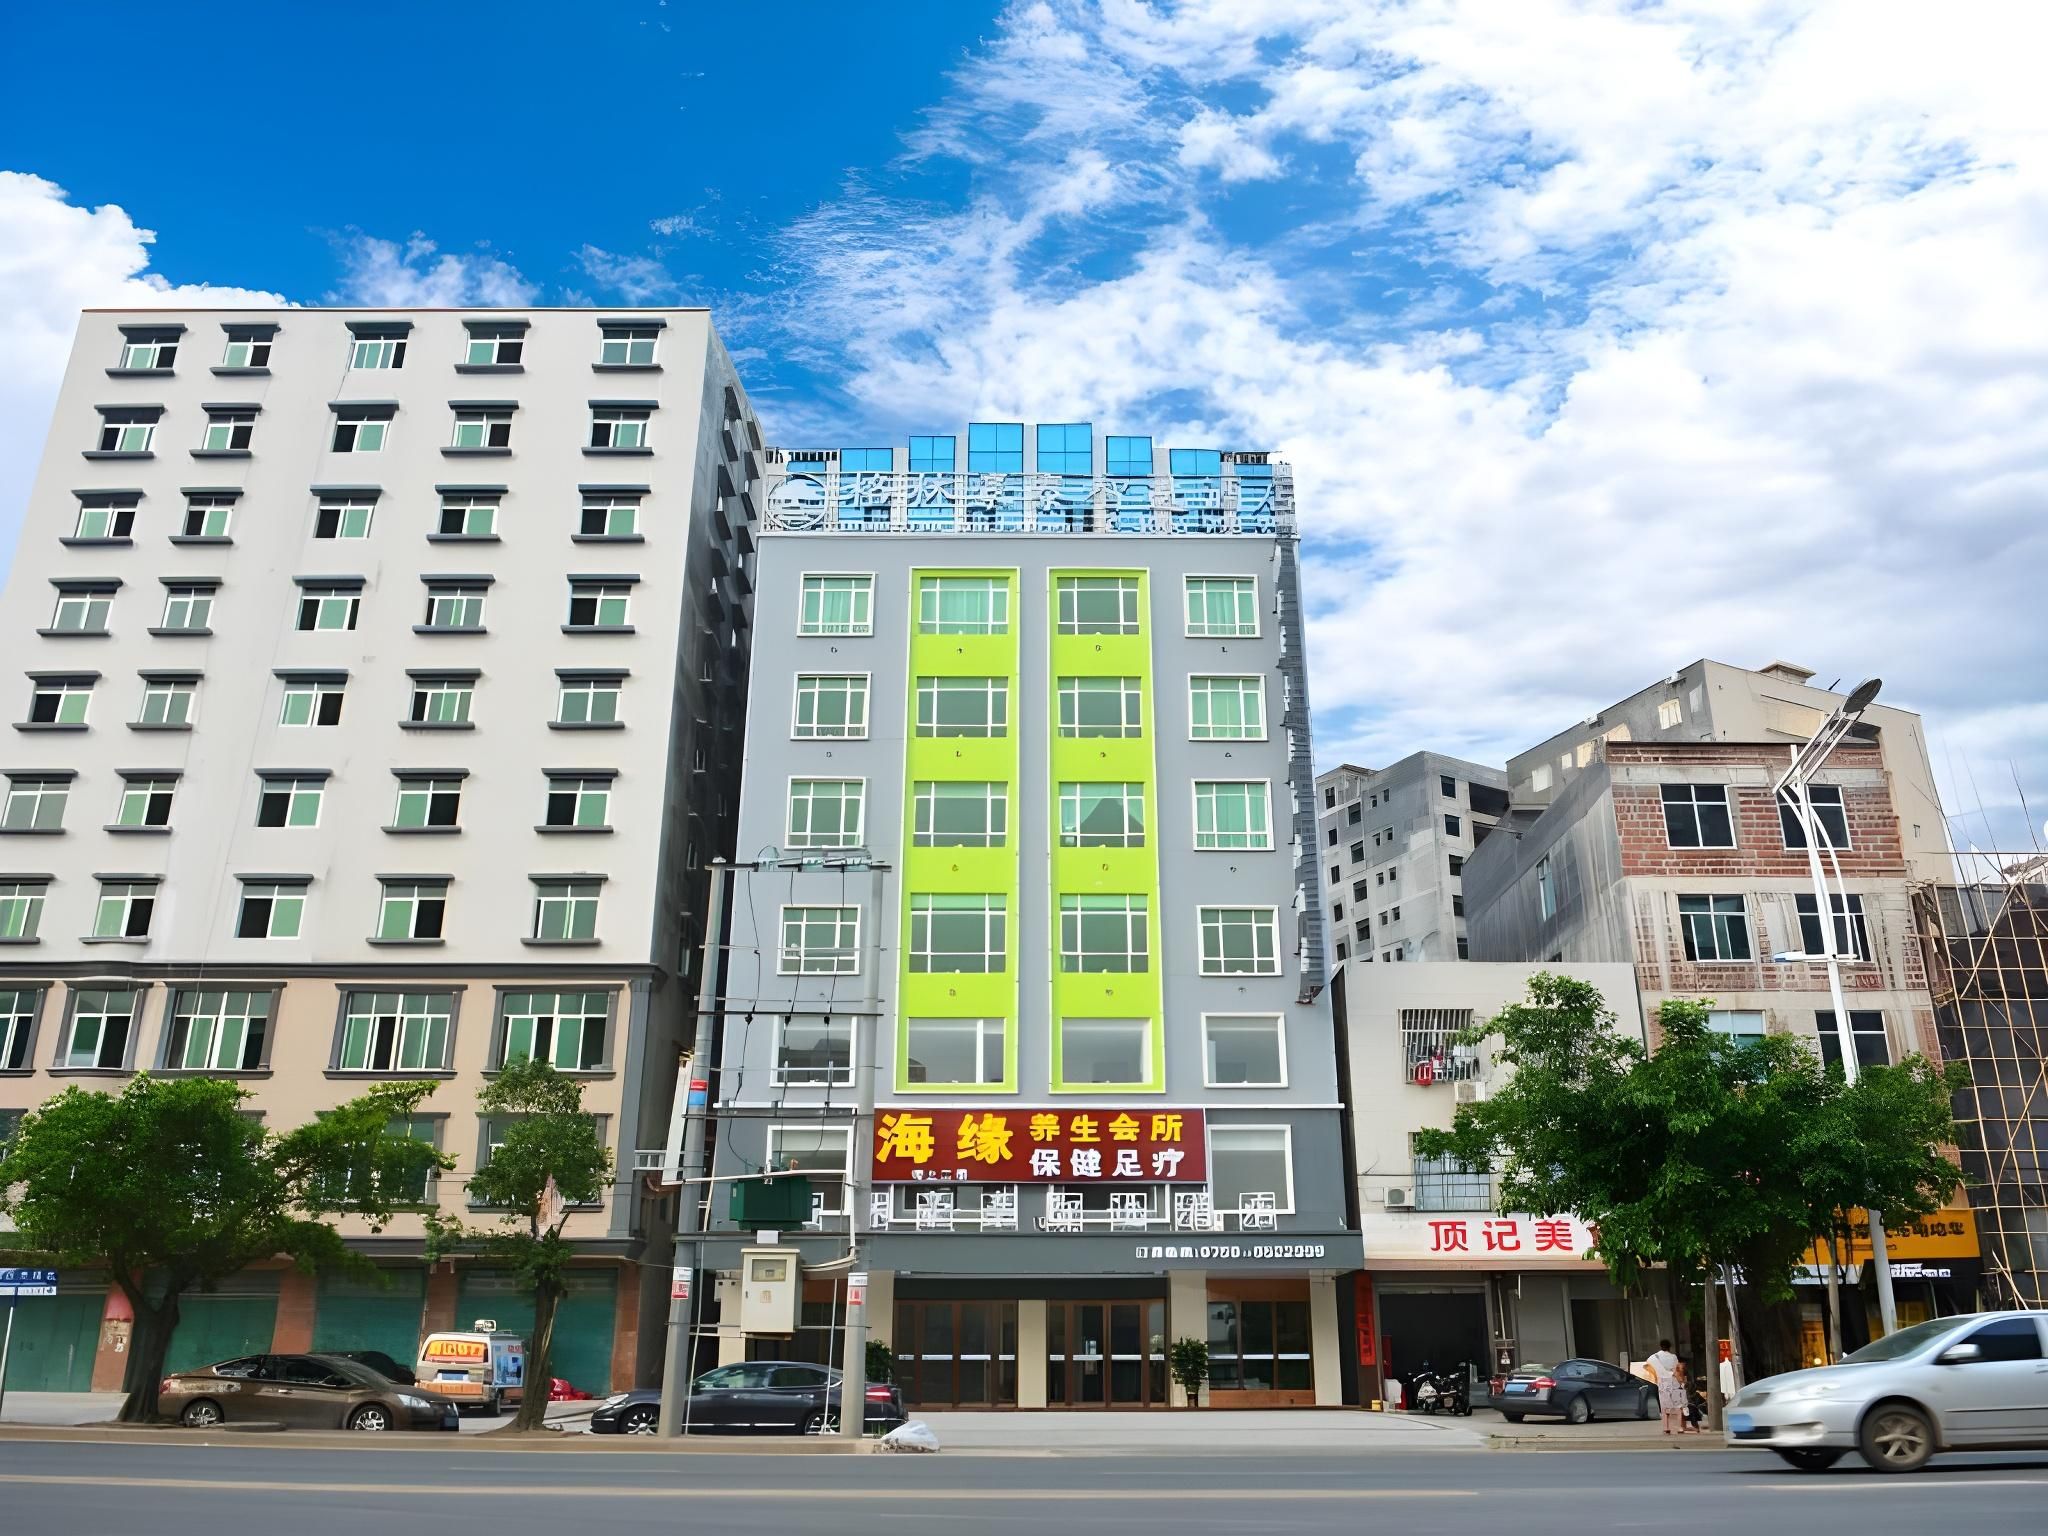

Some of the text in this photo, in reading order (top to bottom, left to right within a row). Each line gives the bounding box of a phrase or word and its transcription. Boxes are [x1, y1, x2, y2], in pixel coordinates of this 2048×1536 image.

[876, 1113, 1013, 1164] 海缘
[1029, 1112, 1183, 1143] 养生会所
[1029, 1148, 1185, 1177] 保健足疗
[1427, 1220, 1600, 1251] 顶记美
